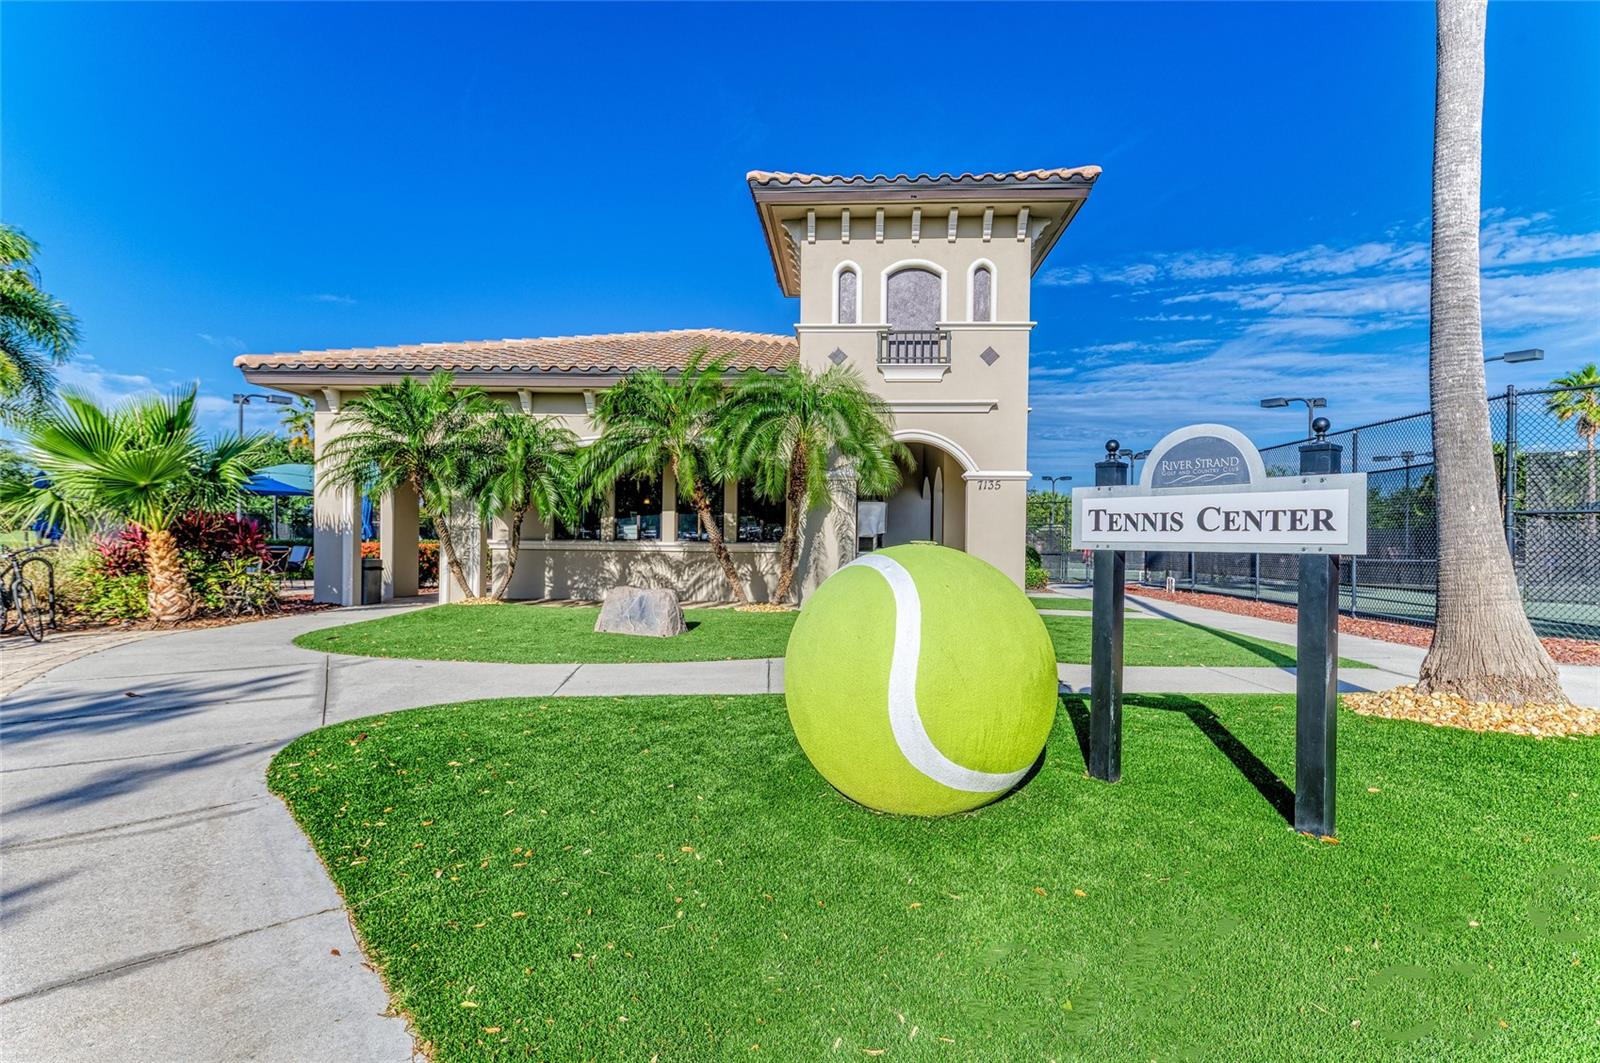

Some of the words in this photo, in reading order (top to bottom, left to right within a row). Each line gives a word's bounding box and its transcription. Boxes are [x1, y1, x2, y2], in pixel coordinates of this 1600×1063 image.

[1162, 460, 1193, 471] RIVER
[1195, 457, 1240, 469] STRAND
[976, 480, 1001, 491] 7135
[1088, 508, 1184, 532] TENNIS
[1197, 506, 1337, 532] CENTER
